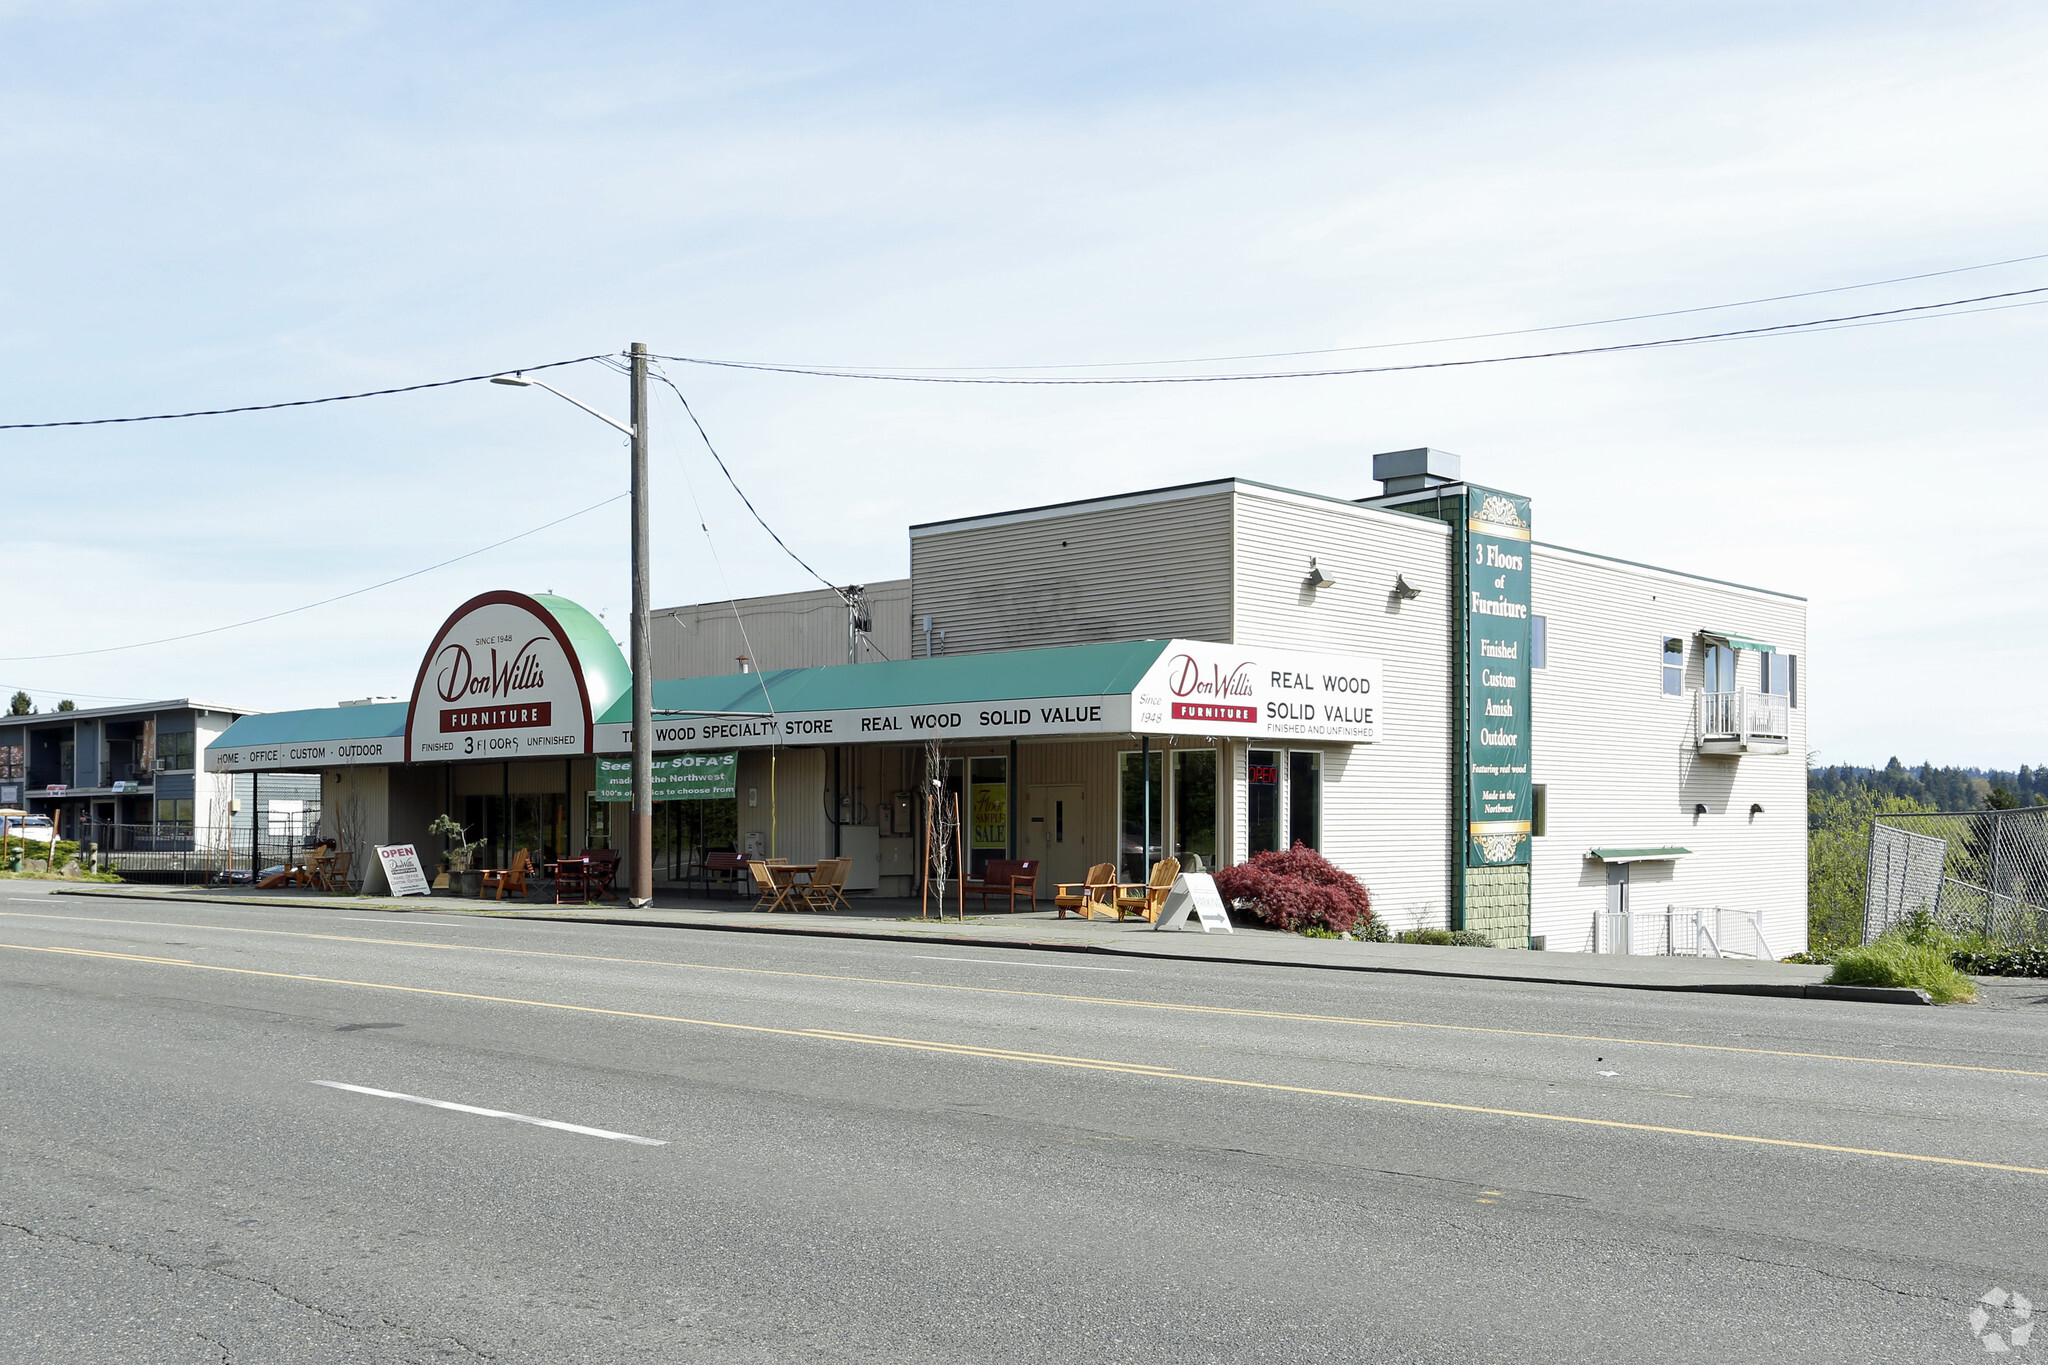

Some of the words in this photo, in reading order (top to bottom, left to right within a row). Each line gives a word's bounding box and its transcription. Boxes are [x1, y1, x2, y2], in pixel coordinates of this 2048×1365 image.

[1476, 543, 1483, 565] 3
[1486, 544, 1523, 571] Floors
[1494, 574, 1506, 589] of
[1471, 591, 1527, 619] Furniture
[475, 638, 495, 646] SINCE
[497, 635, 512, 643] 1948
[1480, 639, 1518, 660] Finished
[435, 644, 490, 702] Don
[490, 636, 550, 699] Willis
[1168, 654, 1213, 697] Don
[1213, 661, 1257, 700] Willis
[1271, 671, 1314, 690] REAL
[1322, 675, 1370, 694] WOOD
[1481, 668, 1516, 688] Custom
[1139, 693, 1162, 706] Since
[1484, 697, 1513, 717] Amish
[452, 708, 538, 727] FURNITURE
[861, 716, 903, 732] REAL
[910, 712, 962, 729] WOOD
[979, 709, 1031, 726] SOLID
[1040, 706, 1102, 723] VALUE
[1140, 712, 1162, 724] 1948
[1181, 706, 1249, 720] FURNITURE
[1266, 701, 1315, 720] SOLID
[1324, 705, 1374, 724] VALUE
[656, 727, 696, 742] WOOD
[702, 721, 778, 739] SPECIALTY
[785, 719, 833, 735] STORE
[1267, 723, 1306, 734] FINISHED
[1307, 725, 1325, 735] AND
[1327, 727, 1374, 737] UNFINISHED
[1480, 727, 1518, 747] Outdoor
[421, 742, 454, 752] FINISHED
[464, 736, 474, 754] 3
[527, 735, 575, 746] UNFINISHED
[217, 753, 239, 764] HOME
[250, 750, 278, 762] OFFICE
[290, 748, 326, 759] CUSTOM
[338, 744, 382, 757] OUTDOOR
[600, 761, 632, 771] See
[651, 761, 669, 770] ur
[672, 755, 735, 768] SOFA'S
[1472, 763, 1499, 776] Featuring
[1499, 763, 1511, 774] real
[1511, 763, 1527, 774] wood
[609, 777, 632, 785] mad
[669, 772, 725, 783] Northwest
[1249, 766, 1277, 783] OPEN
[601, 789, 622, 797] 100's
[677, 787, 711, 795] choose
[713, 786, 735, 794] from
[1482, 789, 1499, 801] Made
[1499, 789, 1506, 800] in
[1506, 789, 1516, 800] the
[1484, 802, 1513, 814] Northwest
[976, 813, 1005, 823] SAMPLE
[975, 825, 1006, 842] SALE
[382, 848, 414, 858] OPEN
